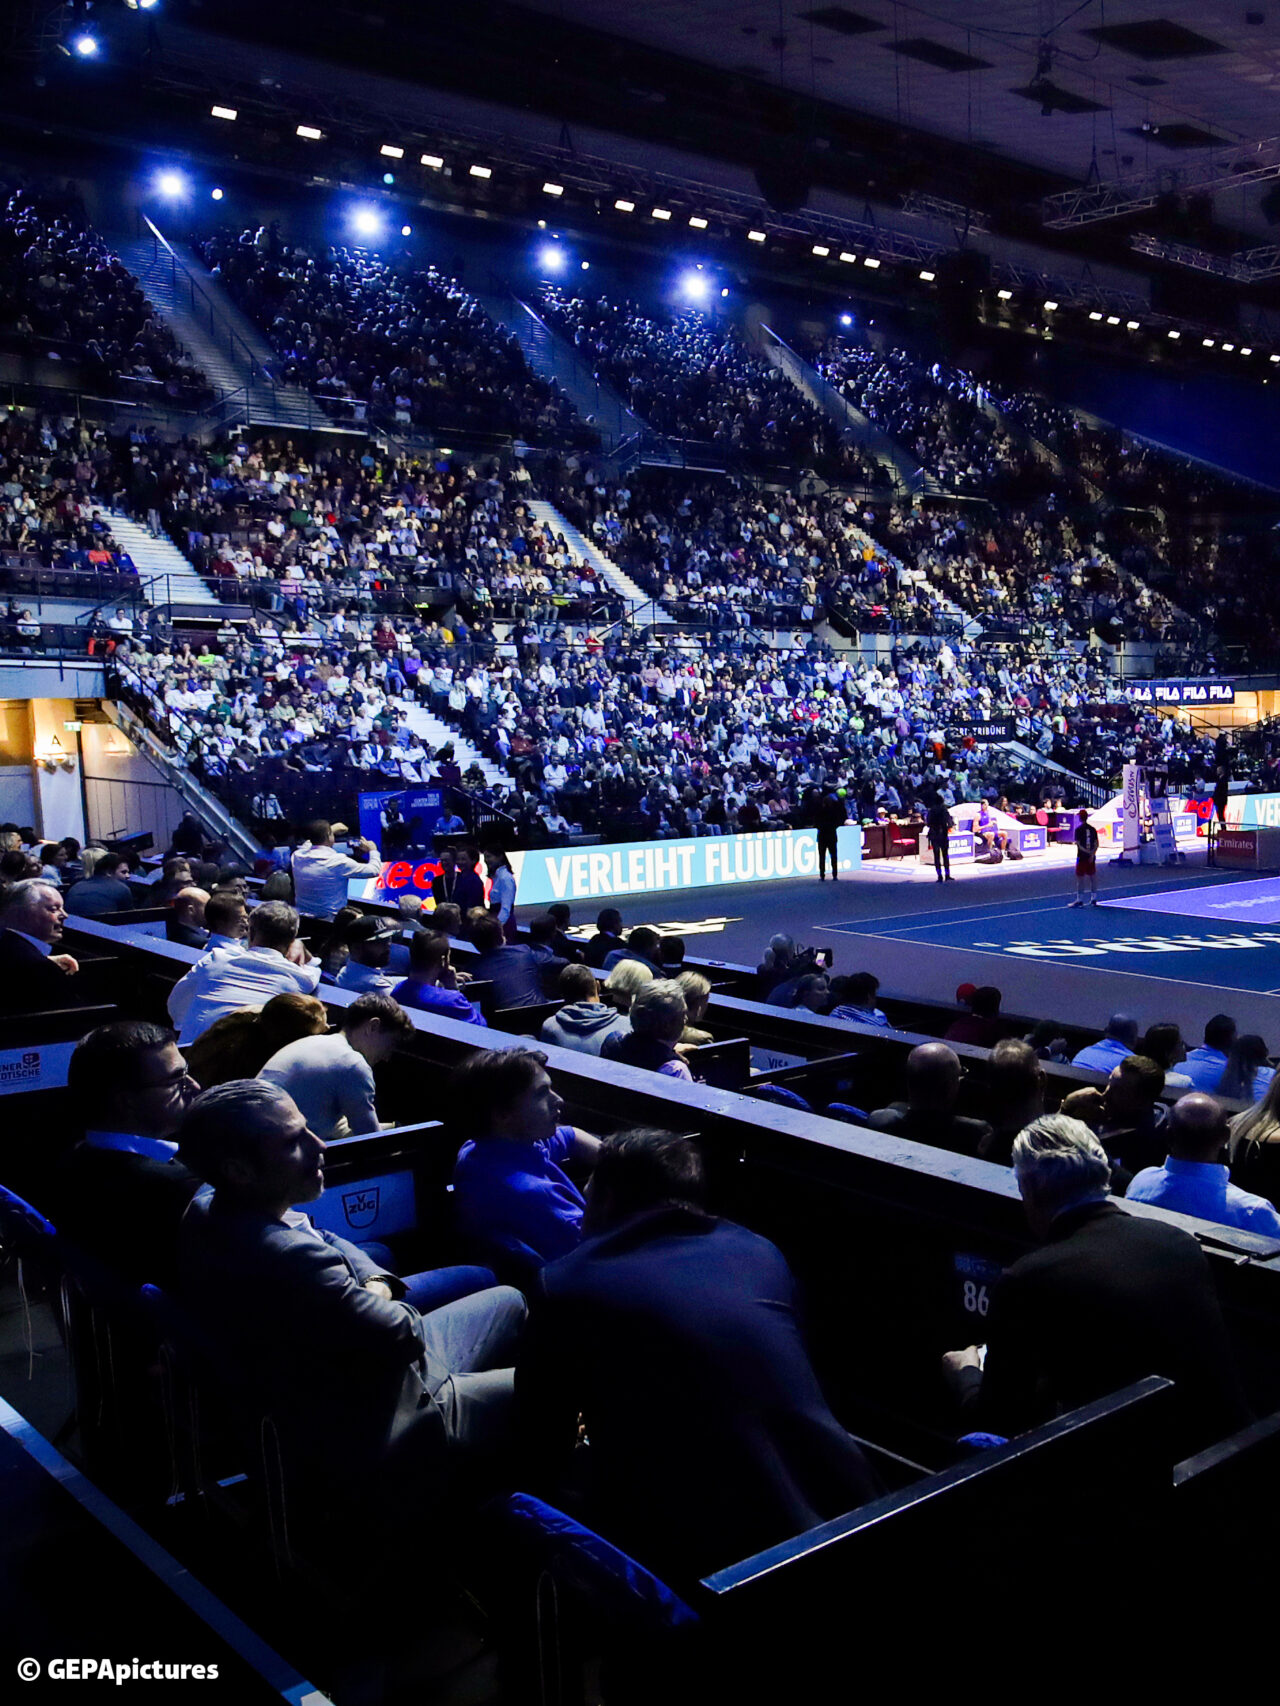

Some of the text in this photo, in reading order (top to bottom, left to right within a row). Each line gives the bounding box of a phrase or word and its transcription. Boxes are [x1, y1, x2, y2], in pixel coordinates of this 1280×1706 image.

[1155, 687, 1180, 701] FILA
[1183, 686, 1207, 700] FILA
[1209, 685, 1233, 699] FILA
[972, 724, 1006, 736] TRIBÜNE
[1218, 838, 1254, 850] Emirates
[544, 830, 851, 899] VERLEIHT FLÜÜÜG.
[0, 1062, 22, 1074] NER
[356, 1194, 366, 1203] V
[349, 1201, 375, 1214] ZUG
[963, 1280, 990, 1317] 86
